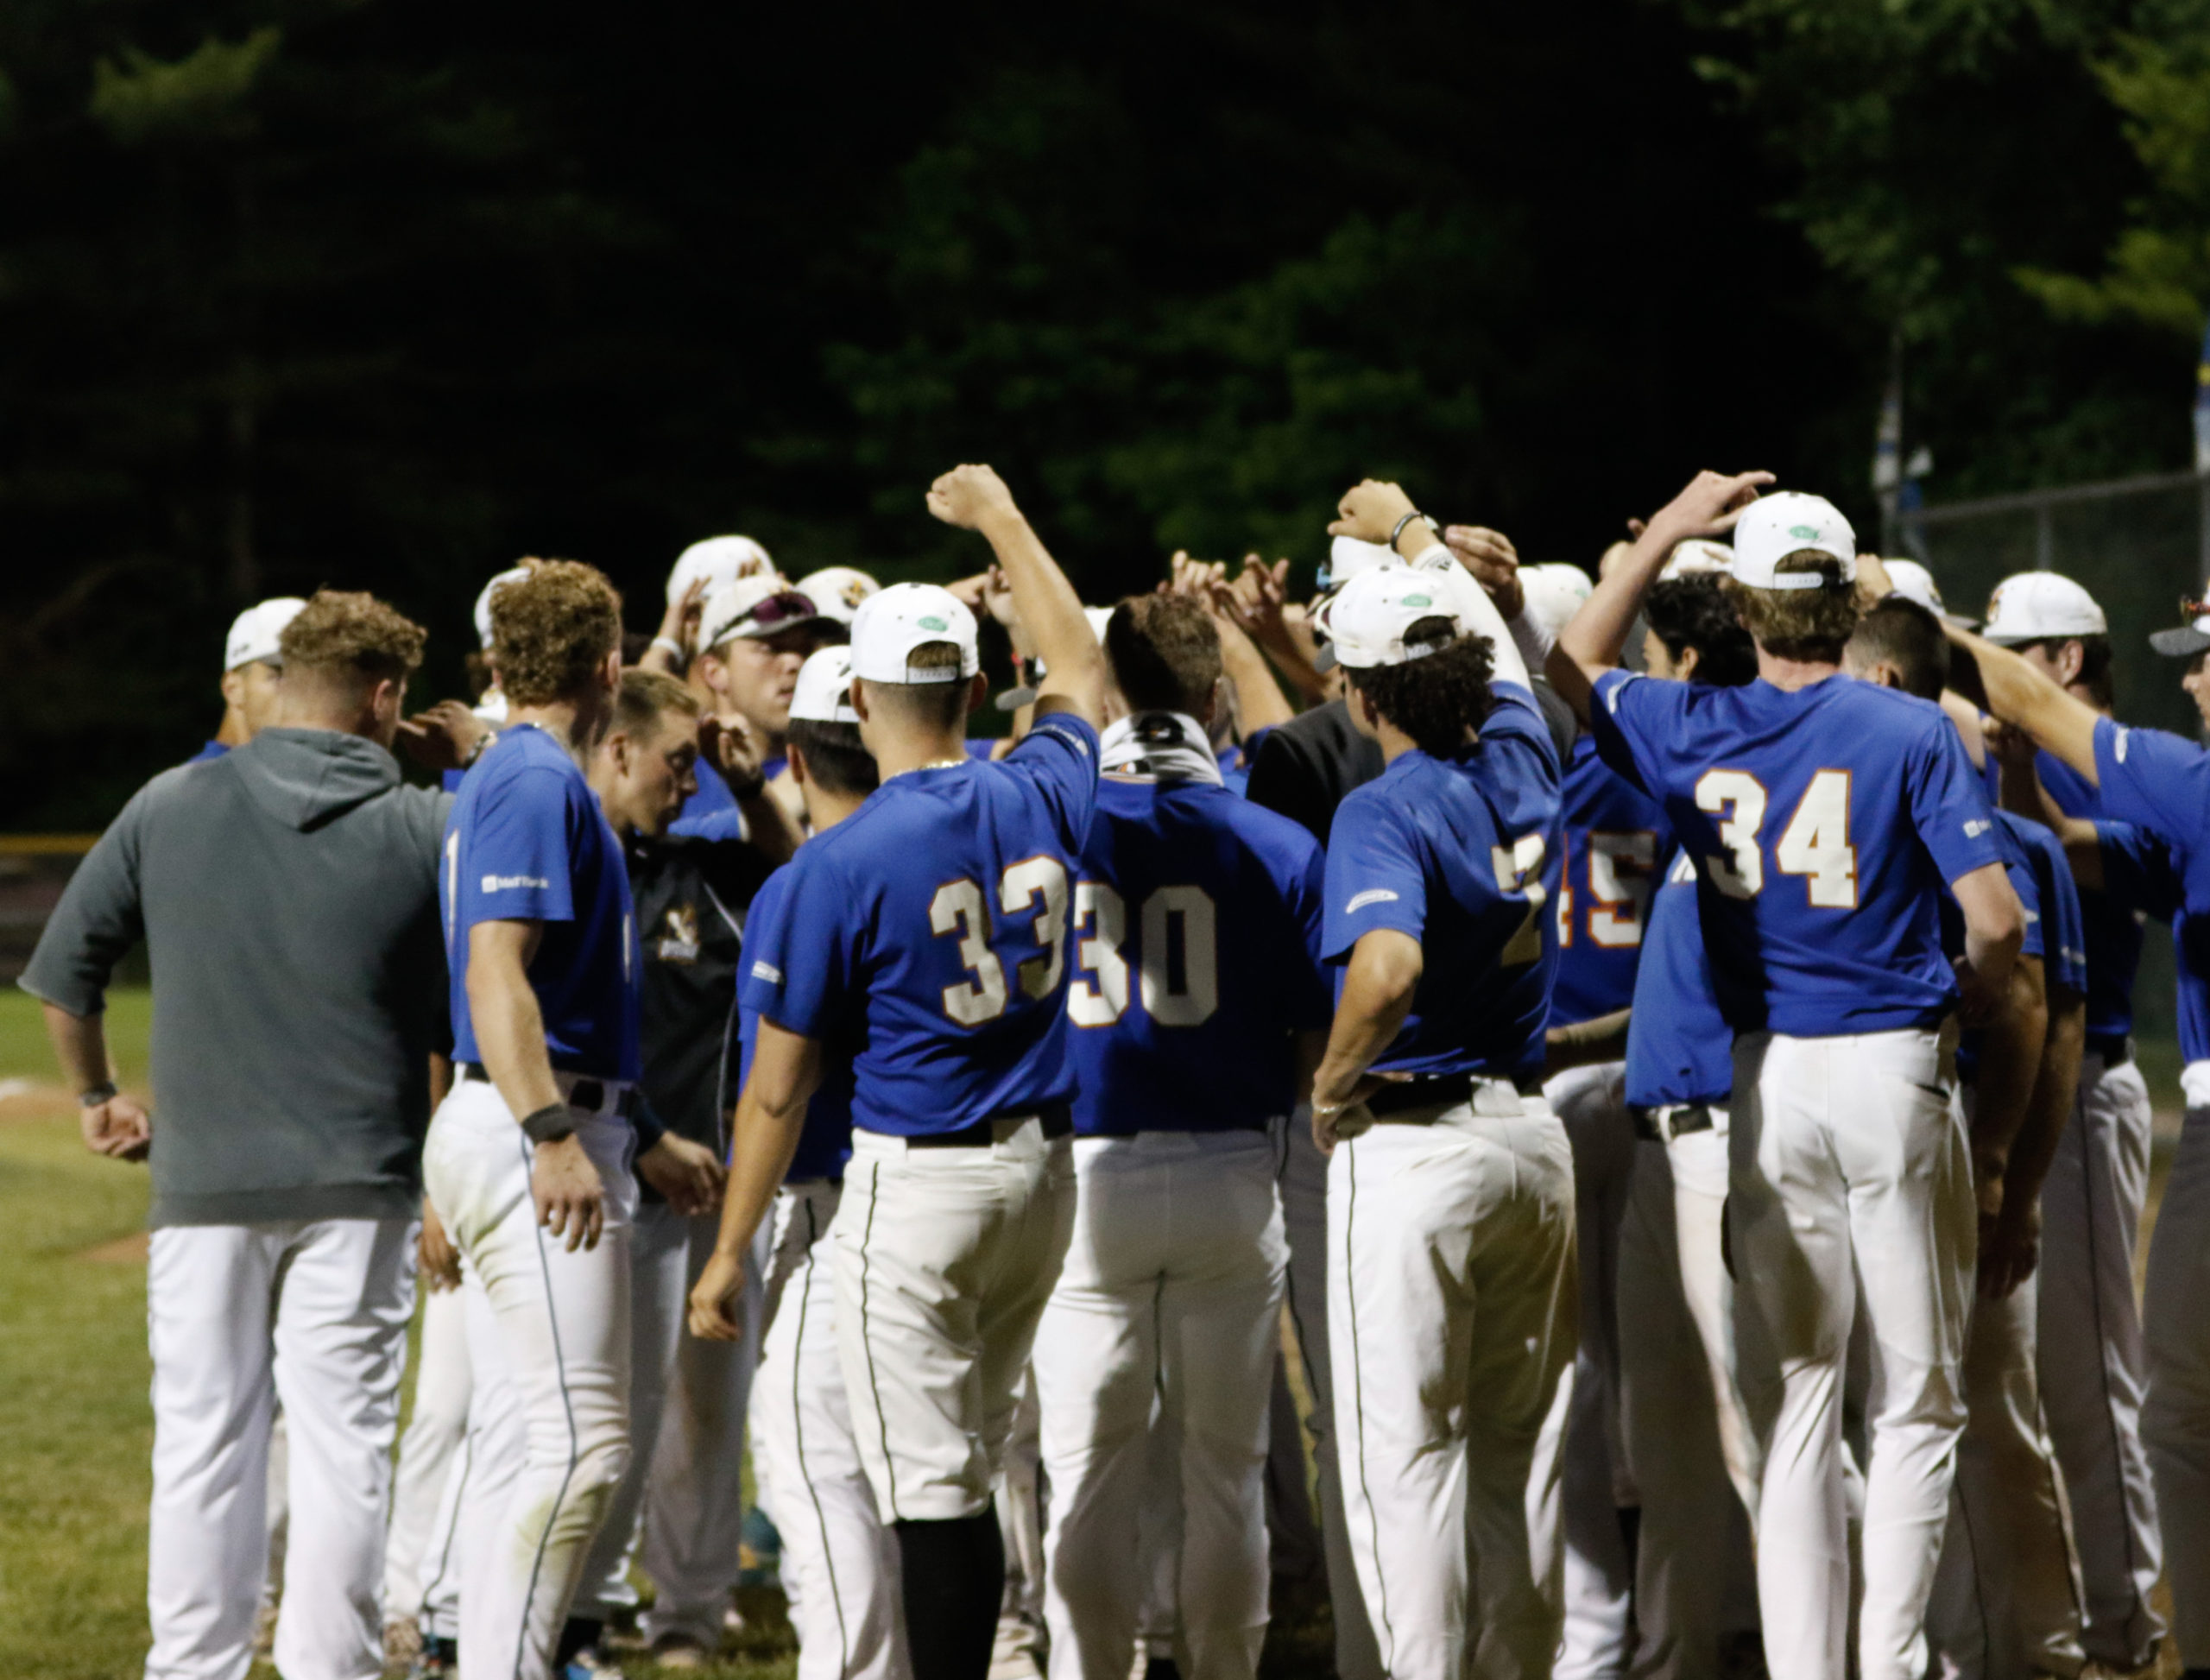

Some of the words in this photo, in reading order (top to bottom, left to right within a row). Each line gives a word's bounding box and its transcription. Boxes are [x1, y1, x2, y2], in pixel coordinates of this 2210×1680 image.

[1556, 831, 1657, 949] 5
[1695, 767, 1858, 909] 34
[929, 854, 1069, 1027] 33
[1067, 881, 1217, 1027] 30
